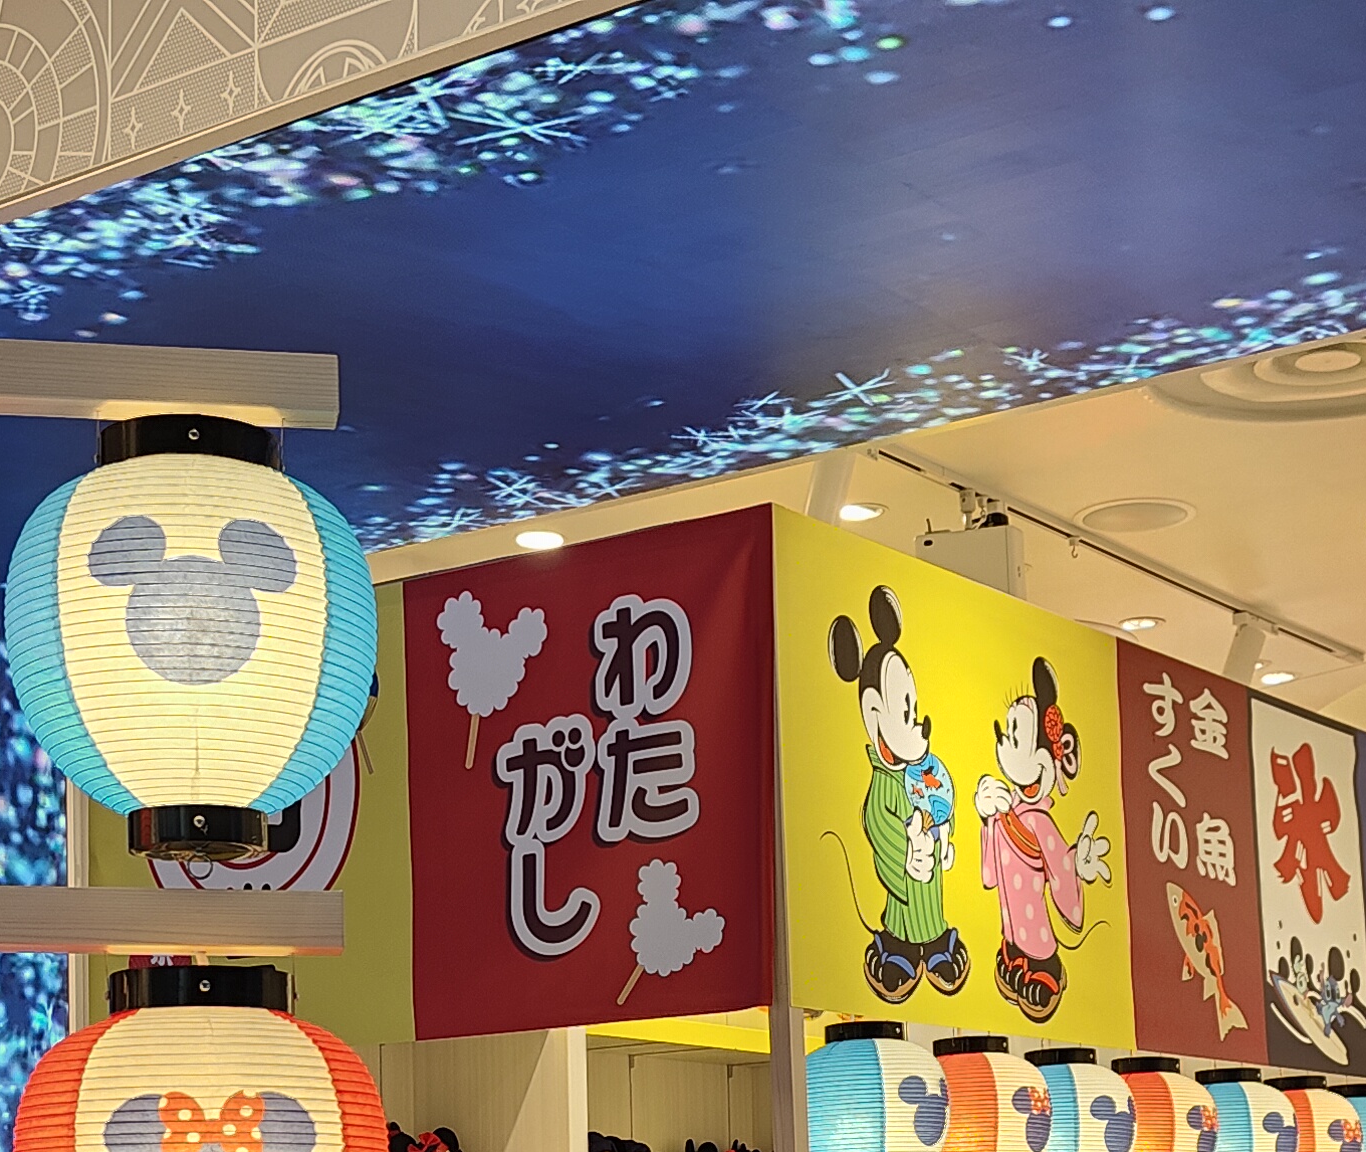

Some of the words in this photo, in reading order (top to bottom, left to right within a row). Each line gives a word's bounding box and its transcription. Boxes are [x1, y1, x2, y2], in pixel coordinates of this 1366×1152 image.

[593, 594, 698, 843] わた
[1142, 672, 1189, 870] すくい
[1189, 688, 1236, 887] 金魚
[495, 715, 599, 958] がし
[1271, 742, 1351, 925] 氷
